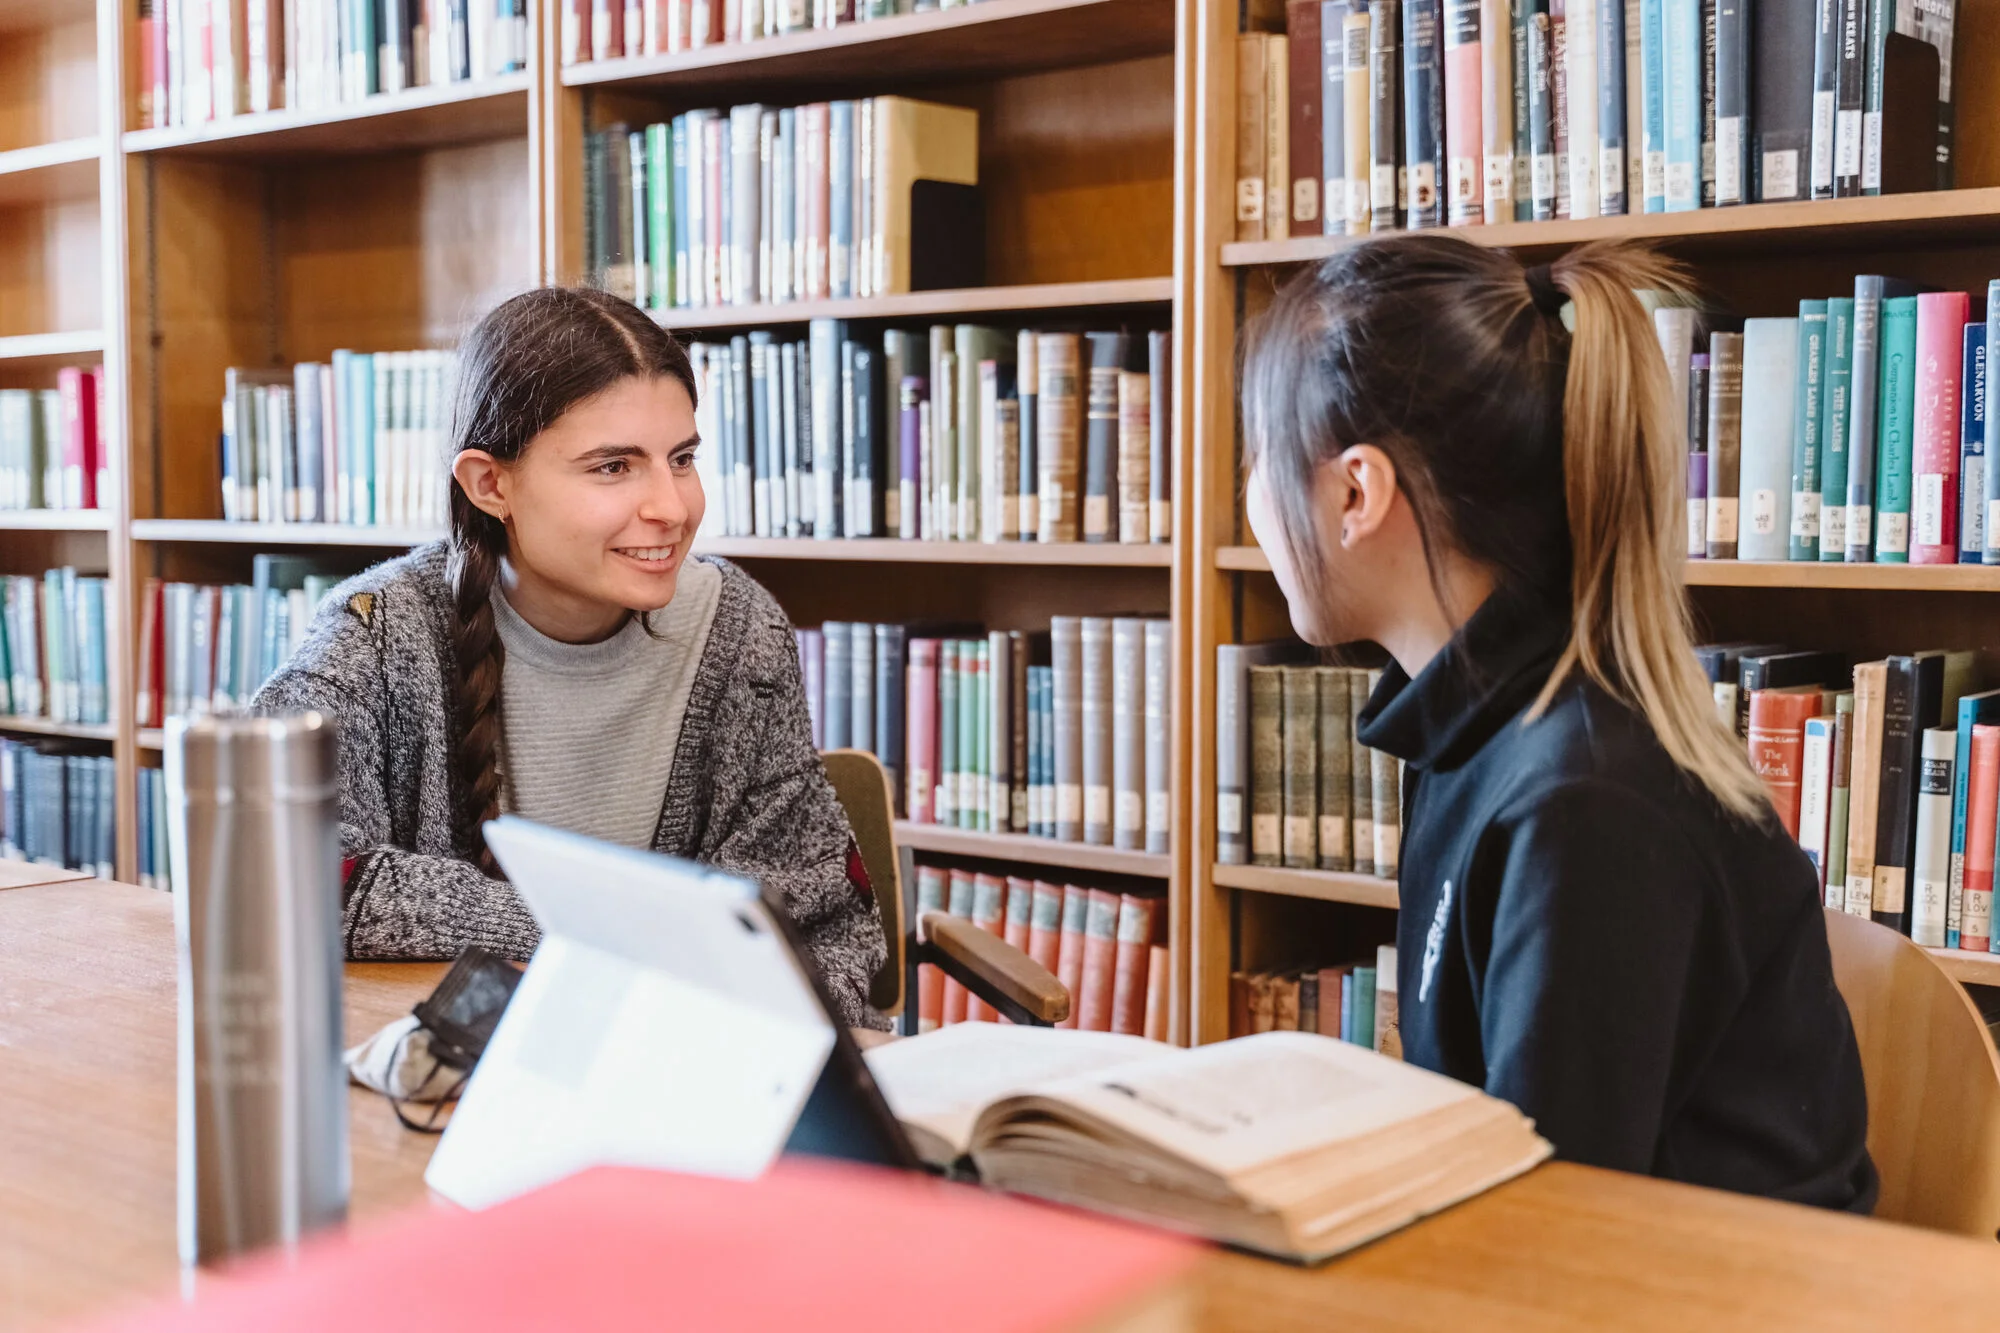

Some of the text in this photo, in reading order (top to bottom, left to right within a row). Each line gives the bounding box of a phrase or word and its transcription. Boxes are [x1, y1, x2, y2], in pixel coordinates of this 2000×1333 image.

[1554, 22, 1567, 73] KEATS
[1845, 21, 1857, 60] KEATS
[1808, 334, 1819, 385] CHARLES
[1974, 345, 1985, 422] GLENARVON
[1806, 386, 1817, 418] LAMB
[1833, 385, 1845, 411] THE
[1943, 378, 1953, 422] SARAH
[1805, 420, 1816, 444] AND
[1831, 412, 1844, 453] LAMBS
[1887, 353, 1903, 505] Companion to Charles Lamb
[1804, 446, 1815, 467] HIS
[1763, 748, 1782, 760] The
[1755, 760, 1789, 777] Monk
[1850, 891, 1870, 901] LEW
[1924, 883, 1933, 893] R
[1973, 893, 1981, 903] R
[1966, 904, 1988, 912] LOV
[1948, 917, 1960, 929] R
